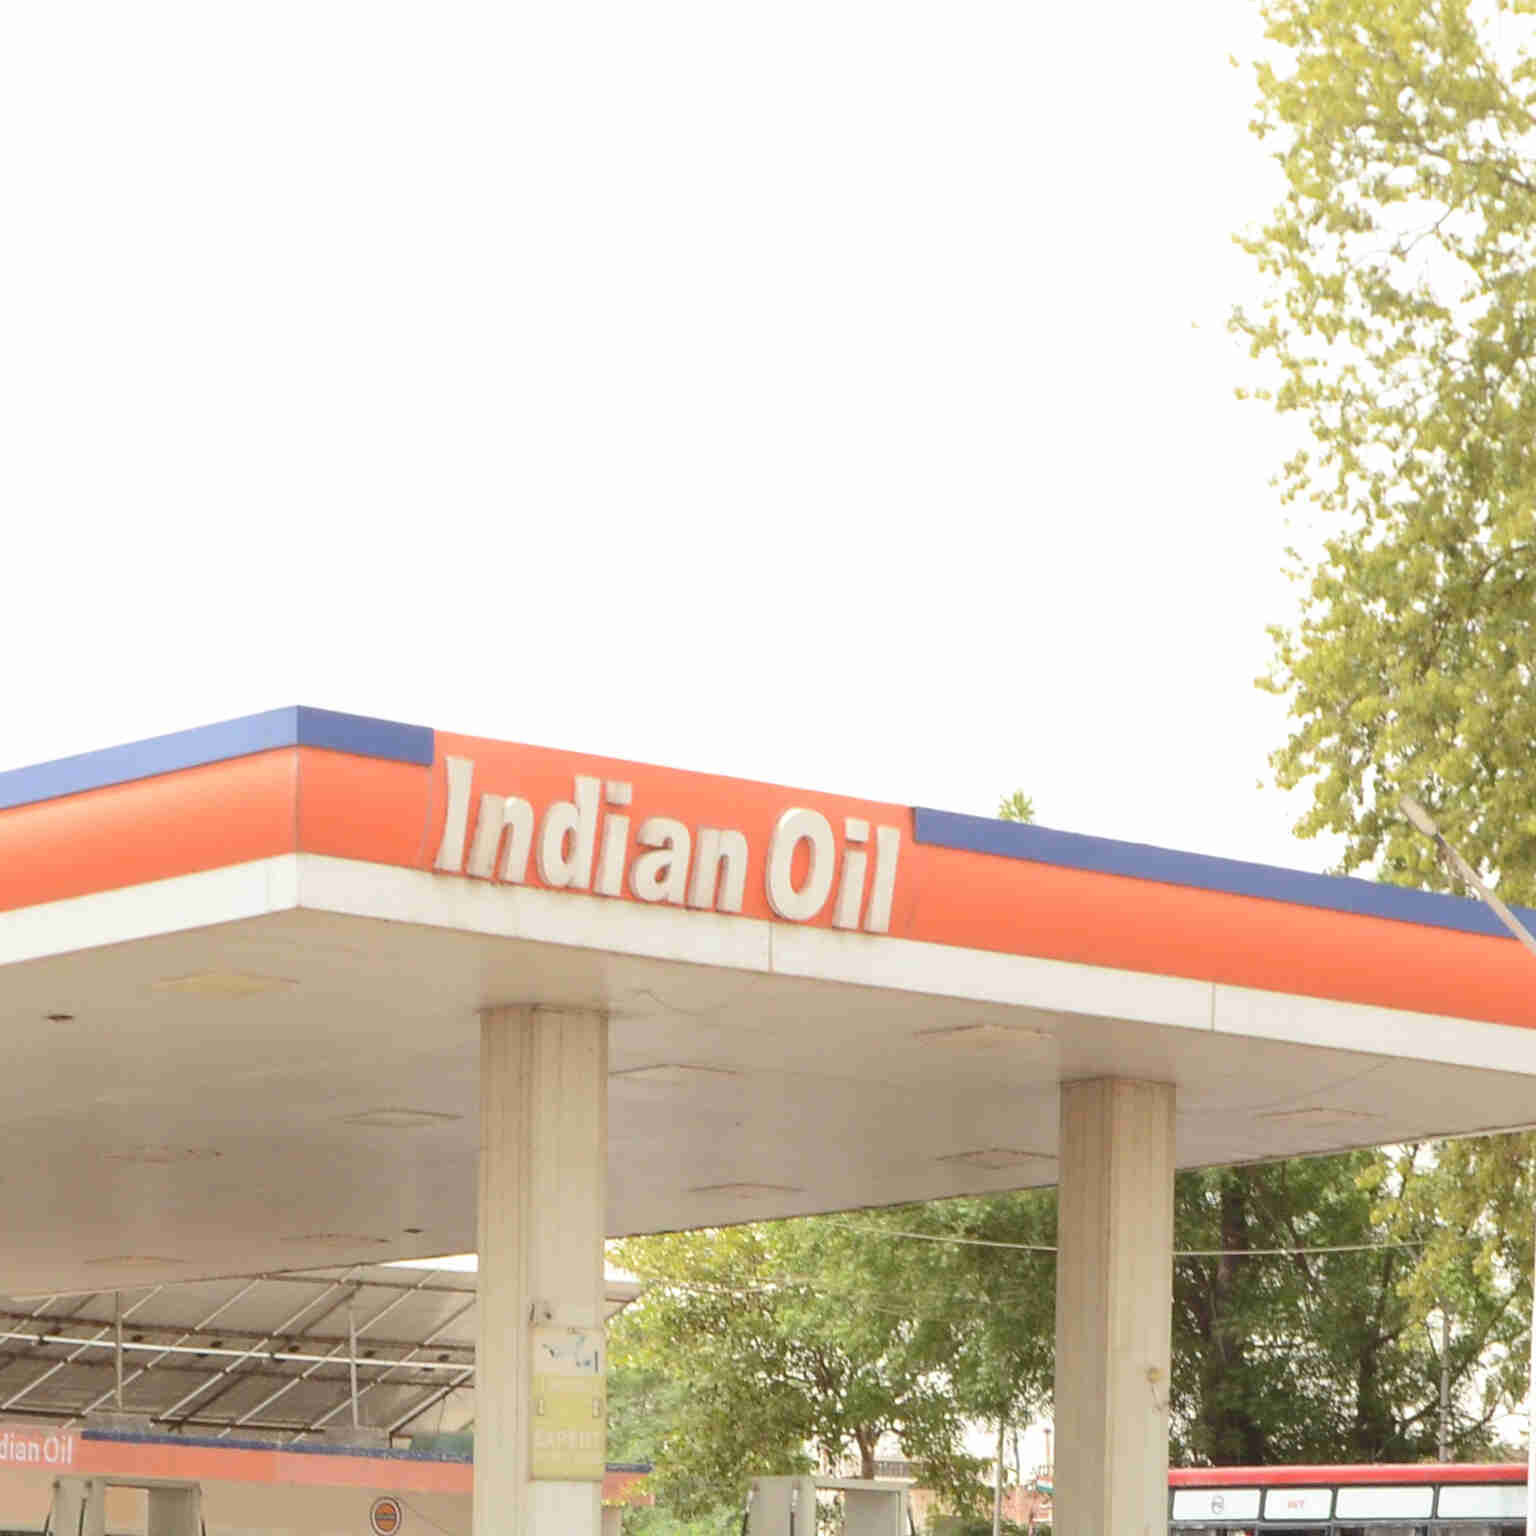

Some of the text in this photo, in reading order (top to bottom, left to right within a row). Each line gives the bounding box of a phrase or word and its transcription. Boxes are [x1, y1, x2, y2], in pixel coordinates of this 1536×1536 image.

[433, 756, 901, 933] Indian Oil
[44, 1435, 73, 1464] Oil
